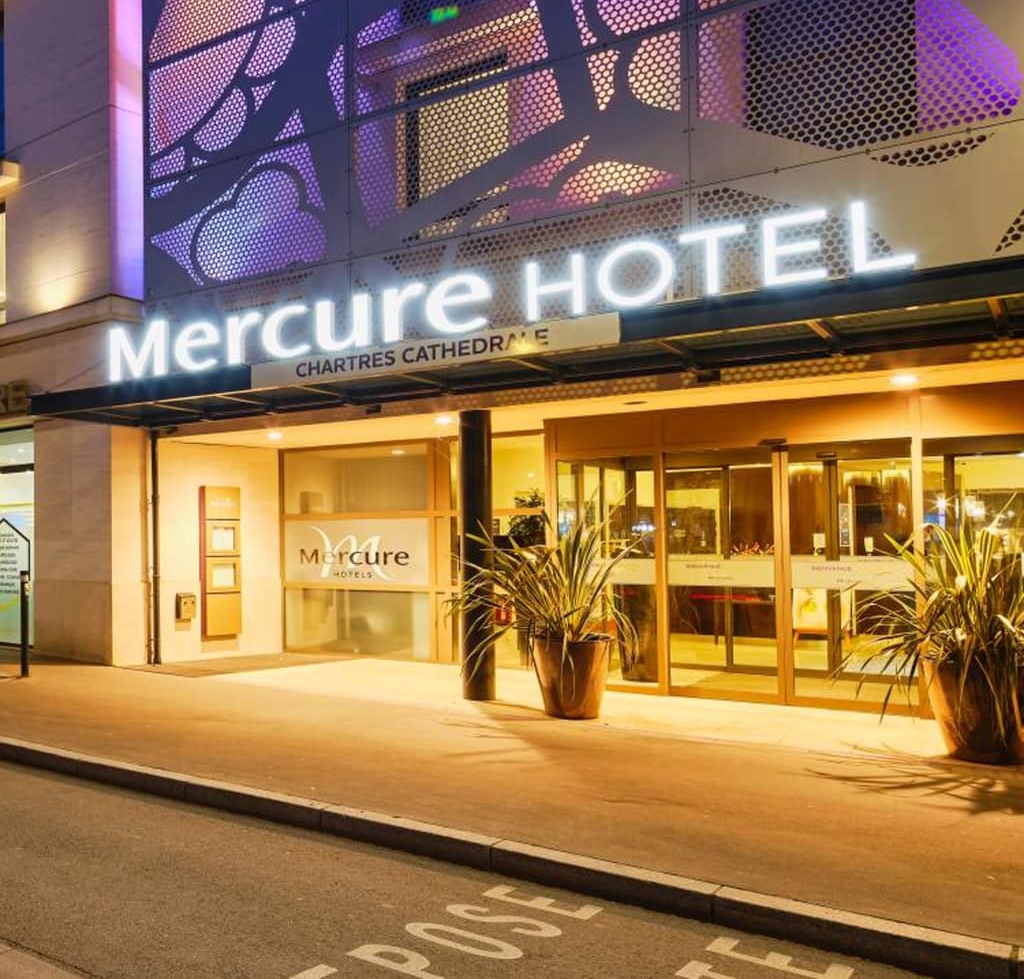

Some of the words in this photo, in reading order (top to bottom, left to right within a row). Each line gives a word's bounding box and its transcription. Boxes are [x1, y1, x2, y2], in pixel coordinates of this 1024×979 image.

[108, 273, 493, 383] Mercure
[525, 201, 917, 321] HOTEL
[295, 350, 396, 378] CHARTRES
[299, 548, 410, 566] Mercure
[288, 884, 605, 979] POSE
